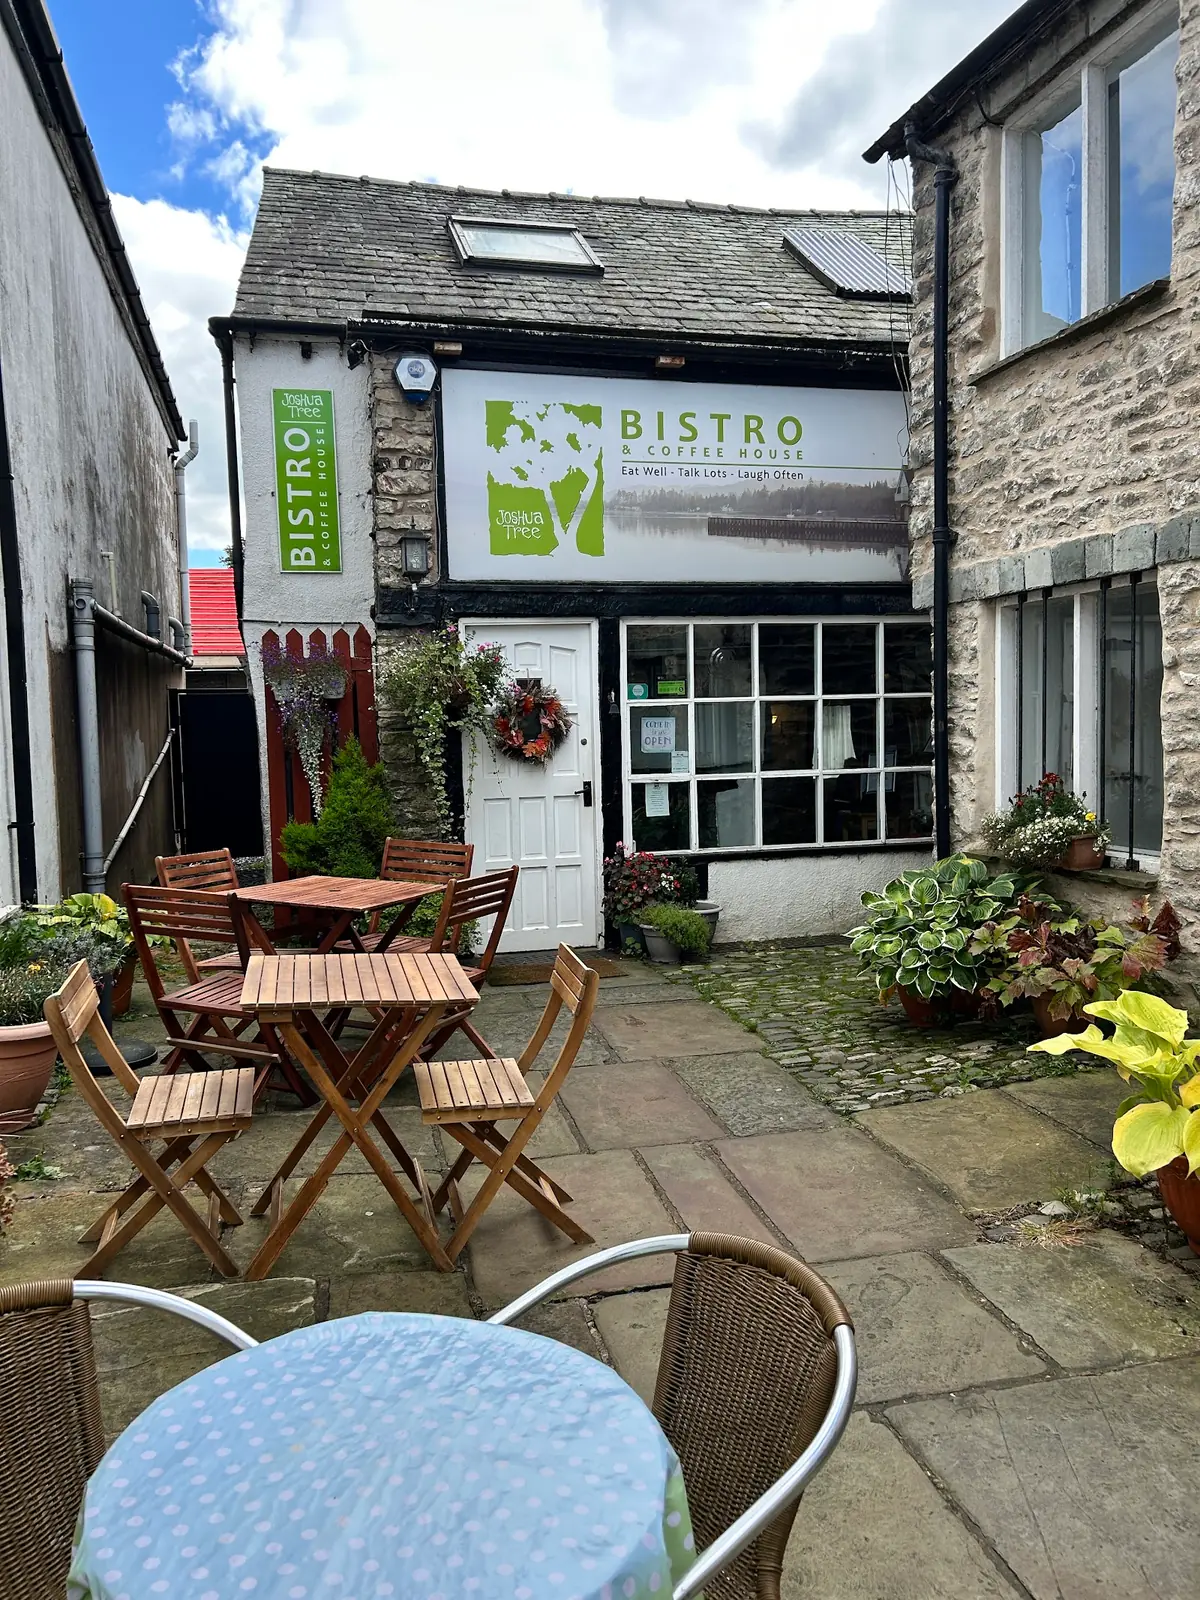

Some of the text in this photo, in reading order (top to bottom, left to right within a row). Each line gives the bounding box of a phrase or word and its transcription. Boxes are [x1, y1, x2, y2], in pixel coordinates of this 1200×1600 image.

[287, 405, 321, 418] Tree
[621, 409, 803, 446] BISTRO
[621, 444, 804, 460] & COFFEE HOUSE
[621, 466, 639, 476] Eat
[644, 466, 667, 477] Well
[678, 467, 700, 478] Talk
[704, 468, 727, 478] Lots
[738, 469, 770, 482] Laugh
[773, 470, 804, 480] Often
[284, 427, 316, 566] BISTRO
[316, 428, 331, 566] & COFFEE HOUSE
[503, 524, 541, 540] Tree
[644, 736, 672, 746] OPEN
